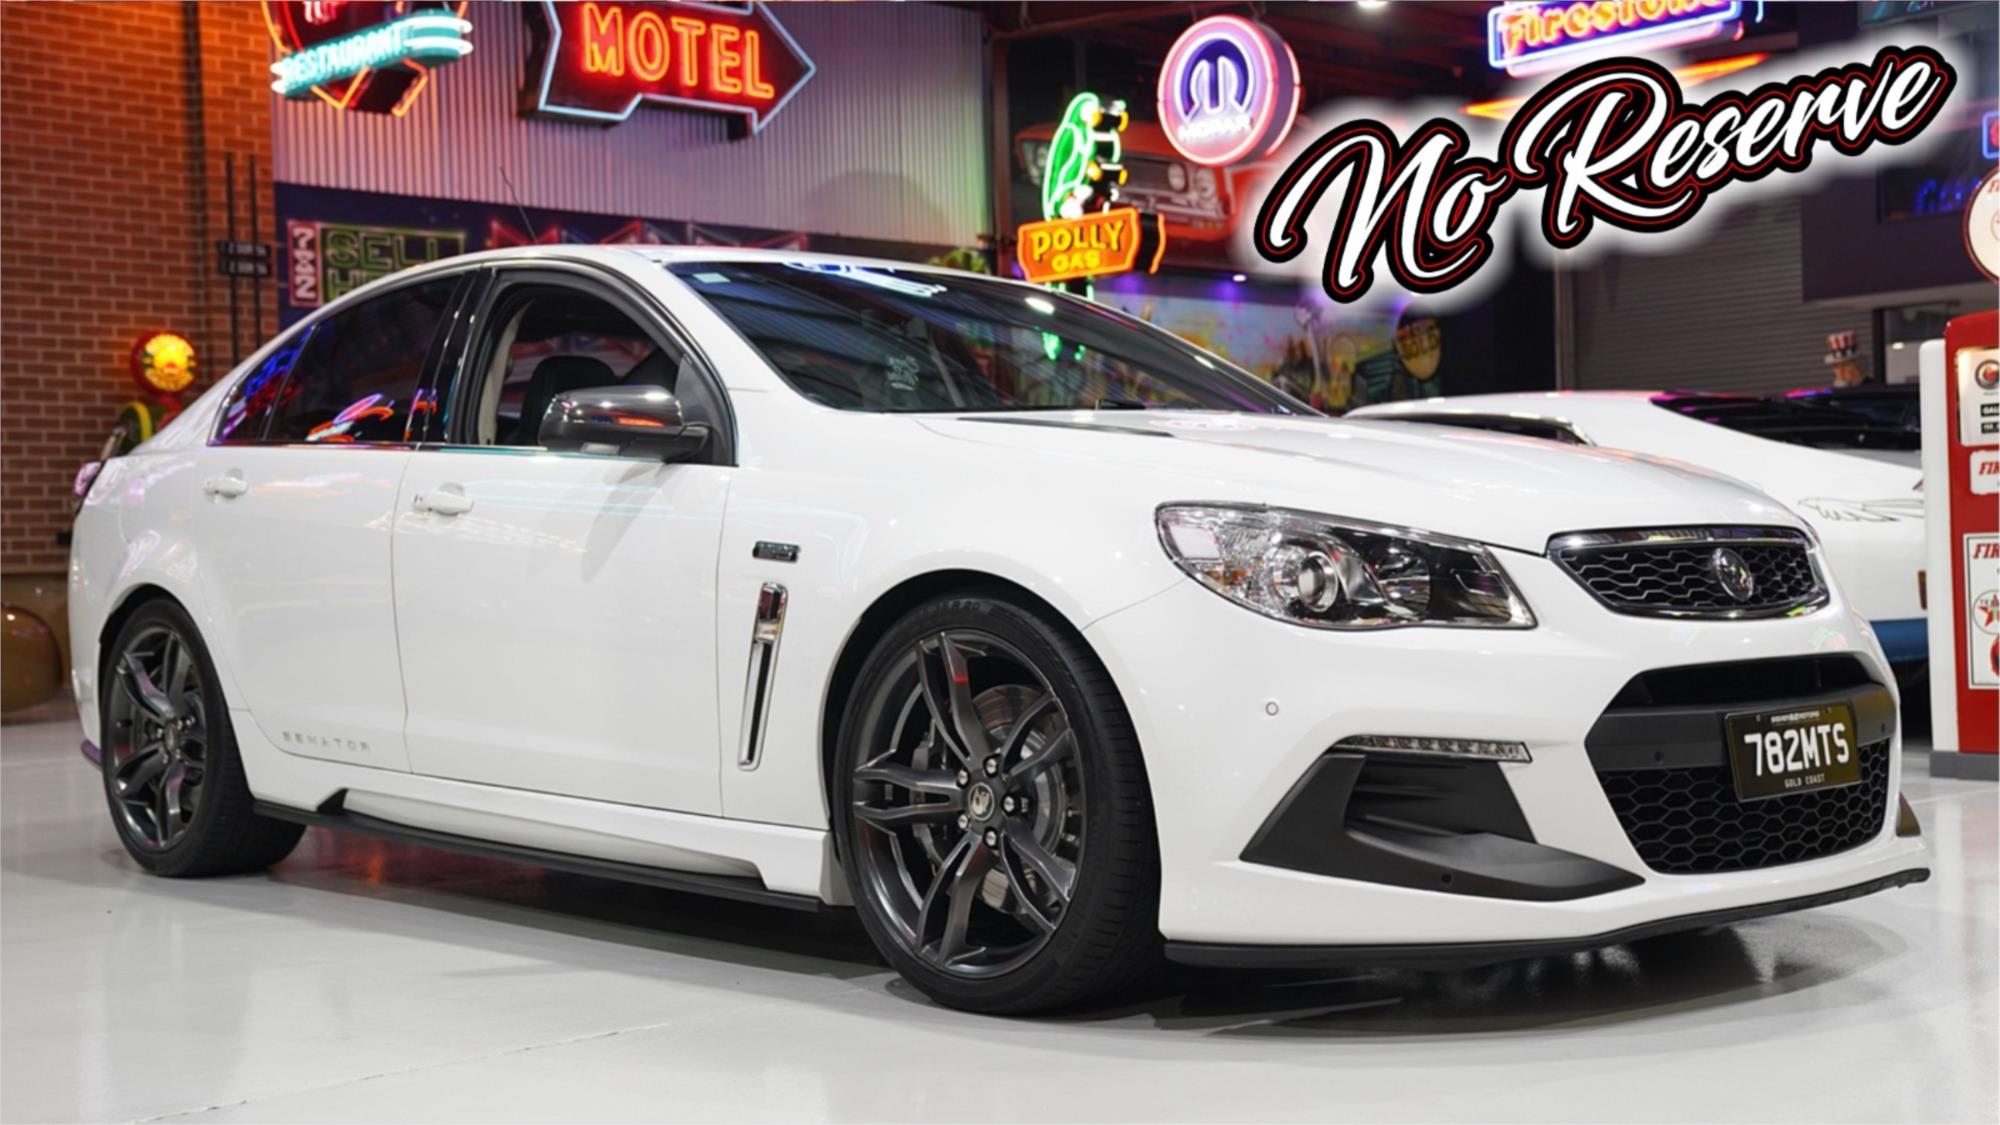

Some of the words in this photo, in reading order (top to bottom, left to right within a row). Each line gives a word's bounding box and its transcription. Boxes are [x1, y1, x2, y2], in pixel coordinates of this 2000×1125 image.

[281, 22, 402, 88] RESTAURANT
[584, 2, 775, 99] MOTEL
[1030, 220, 1123, 262] POLLY
[1051, 249, 1101, 273] GAS
[282, 731, 372, 752] SENATOR
[1744, 722, 1849, 777] 782MTS
[1784, 777, 1802, 789] GOLD
[1805, 773, 1825, 785] COAST
